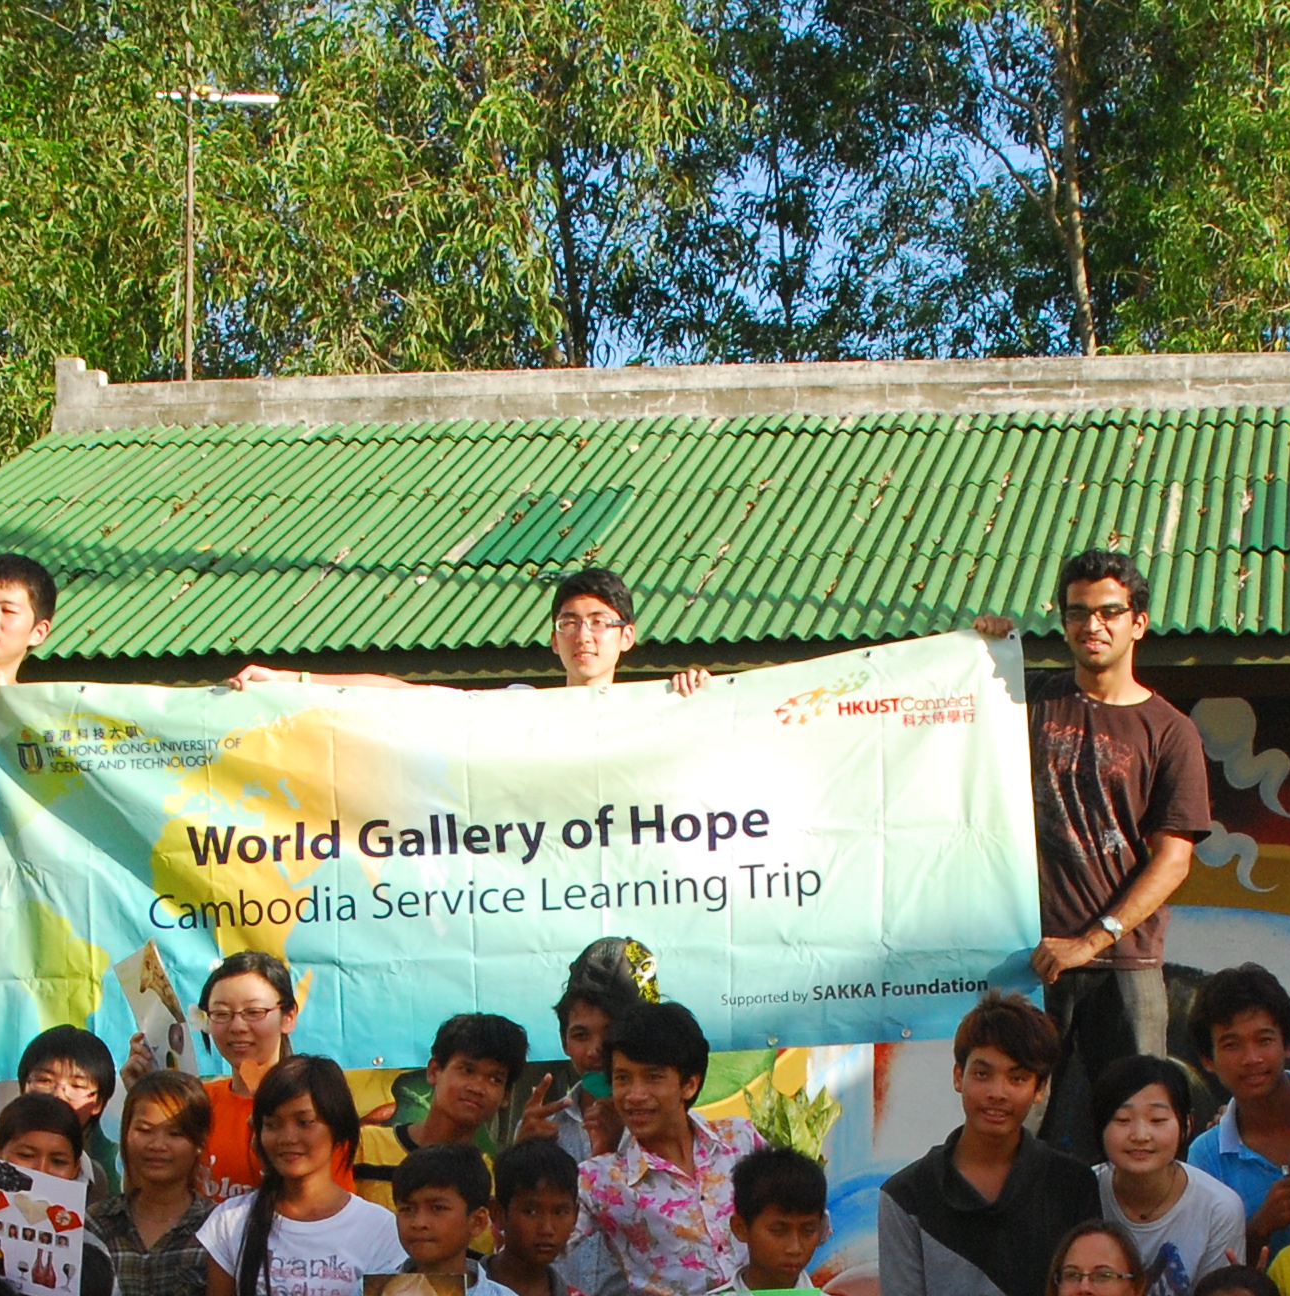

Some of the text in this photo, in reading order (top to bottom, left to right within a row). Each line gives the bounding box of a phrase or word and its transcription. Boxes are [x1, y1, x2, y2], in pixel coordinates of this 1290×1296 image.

[42, 725, 140, 743] 香港科技大學
[45, 737, 242, 758] THE HONG KONG UNIVERSITY OF
[50, 755, 213, 773] SCIENCE AND TECHNOLOGY
[186, 804, 770, 867] World Gallery of Hope
[148, 862, 822, 930] Cambodia Service Learning Trip
[720, 977, 989, 1007] Supported by SAKKA Foundation
